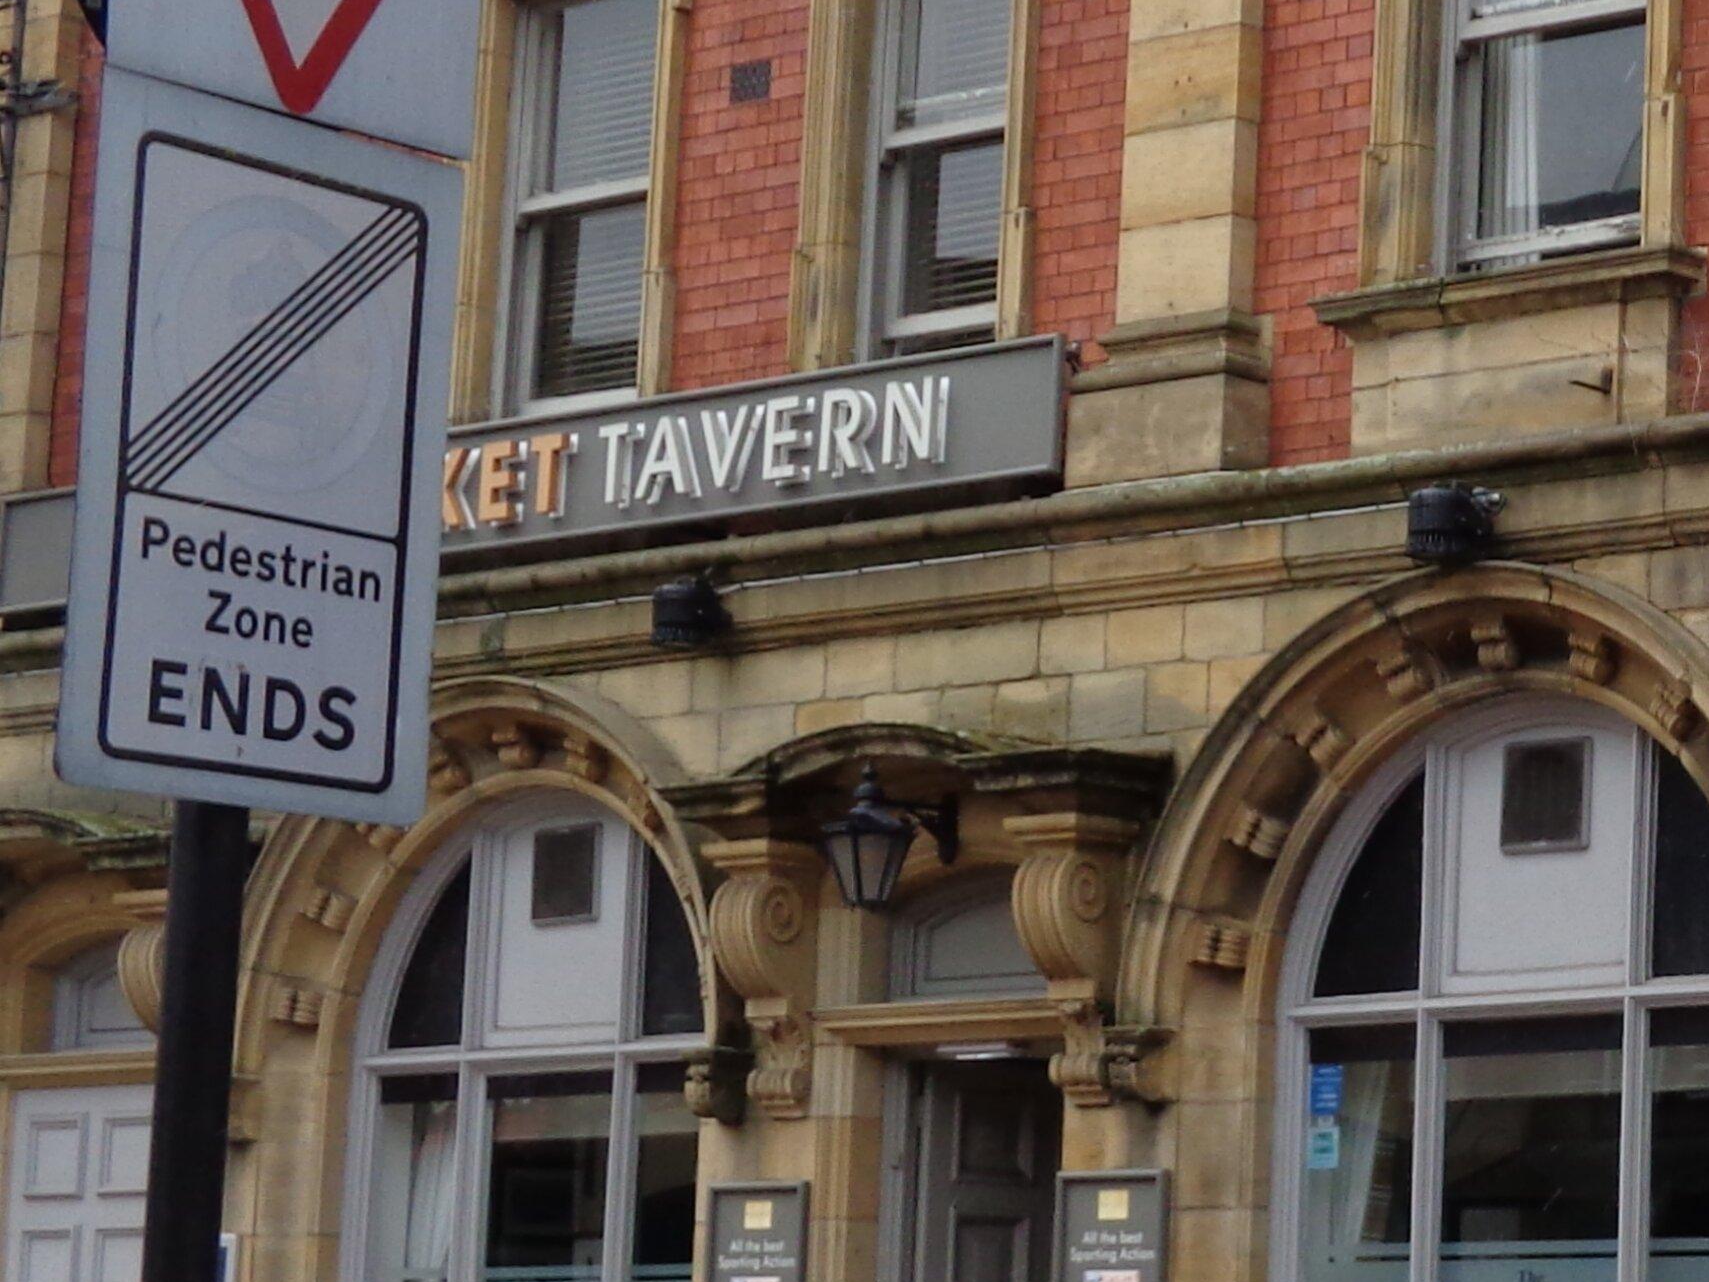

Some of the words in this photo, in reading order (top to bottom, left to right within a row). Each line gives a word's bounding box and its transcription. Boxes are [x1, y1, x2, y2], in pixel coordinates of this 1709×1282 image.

[598, 375, 950, 508] TAVERN
[140, 517, 383, 602] Pedestrian
[204, 590, 316, 651] Zone
[147, 659, 360, 754] ENDS
